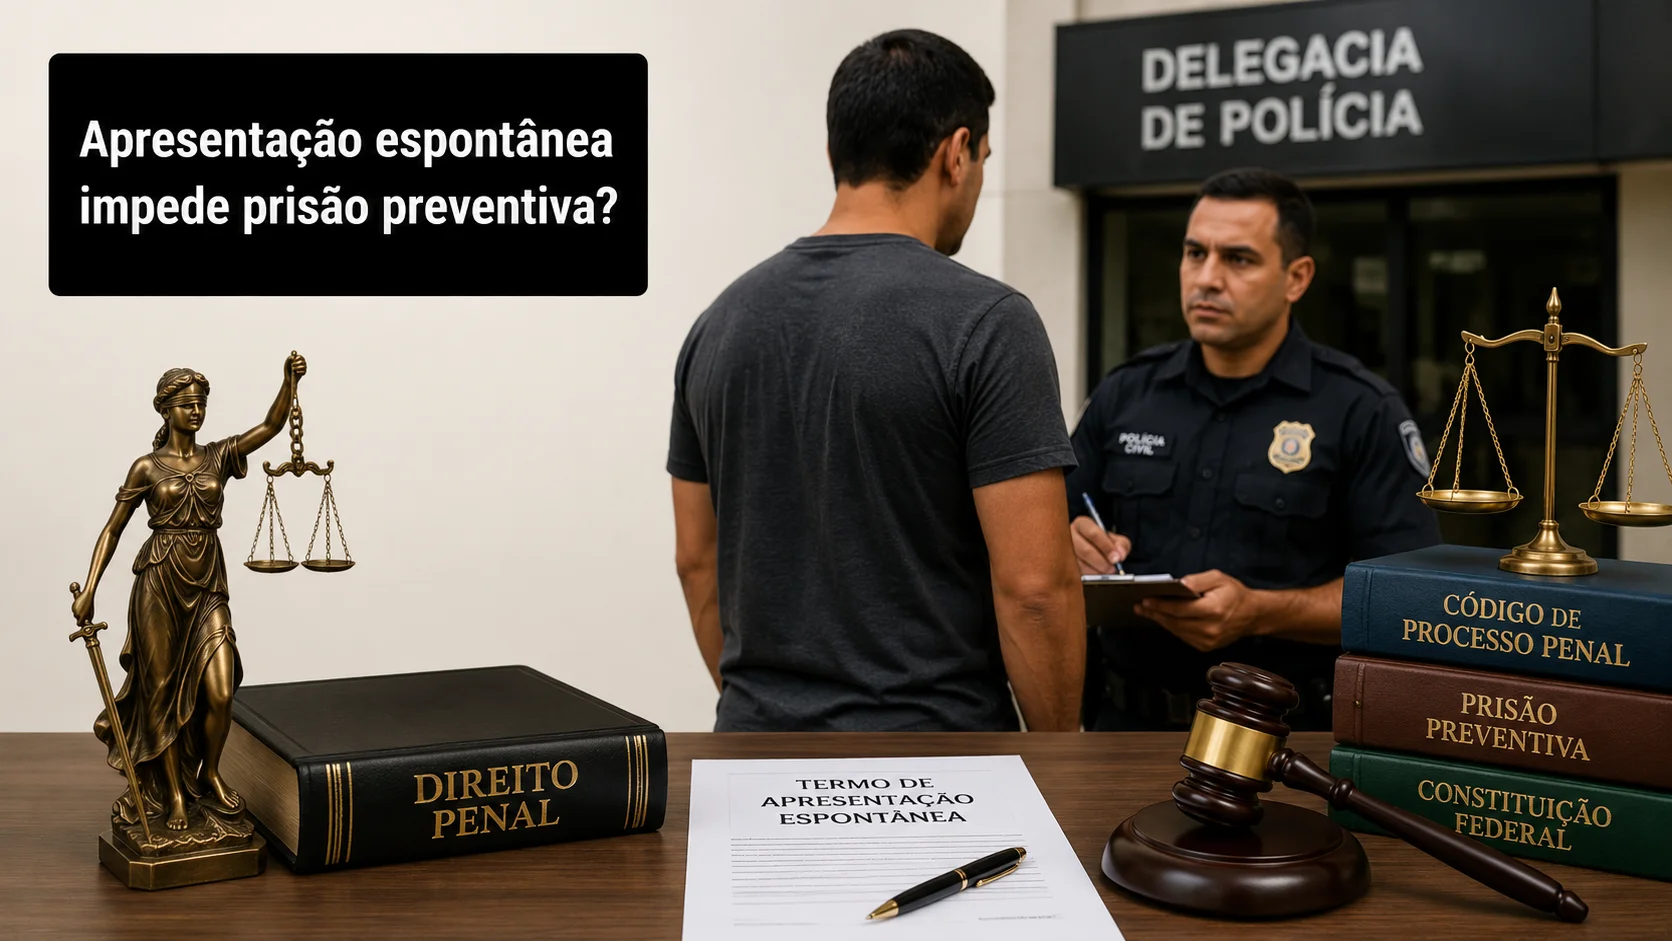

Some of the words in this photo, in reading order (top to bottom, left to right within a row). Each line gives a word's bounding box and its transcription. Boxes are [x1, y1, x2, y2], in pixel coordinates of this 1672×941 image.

[1141, 26, 1424, 93] DELEGACIA
[1141, 103, 1205, 150] DE
[1220, 82, 1424, 146] POLÍCIA
[1118, 432, 1165, 447] POLÍCIA
[1124, 444, 1154, 455] CIVIL
[1443, 590, 1544, 625] CÓDIGO
[1550, 607, 1582, 630] DE
[1402, 618, 1534, 655] PROCESSO
[1541, 635, 1631, 667] PENAL
[1460, 692, 1558, 726] PRISÃO
[1425, 717, 1591, 762] PREVENTIVA
[413, 759, 579, 805] DIREITO
[761, 792, 974, 808] APRESENTAÇÃO
[795, 778, 891, 790] TERMO
[899, 777, 935, 789] DE
[431, 798, 560, 840] PENAL
[779, 810, 967, 825] ESPONTÂNEA
[1417, 779, 1612, 828] CONSTITUIÇÃO
[1454, 812, 1573, 851] FEDERAL
